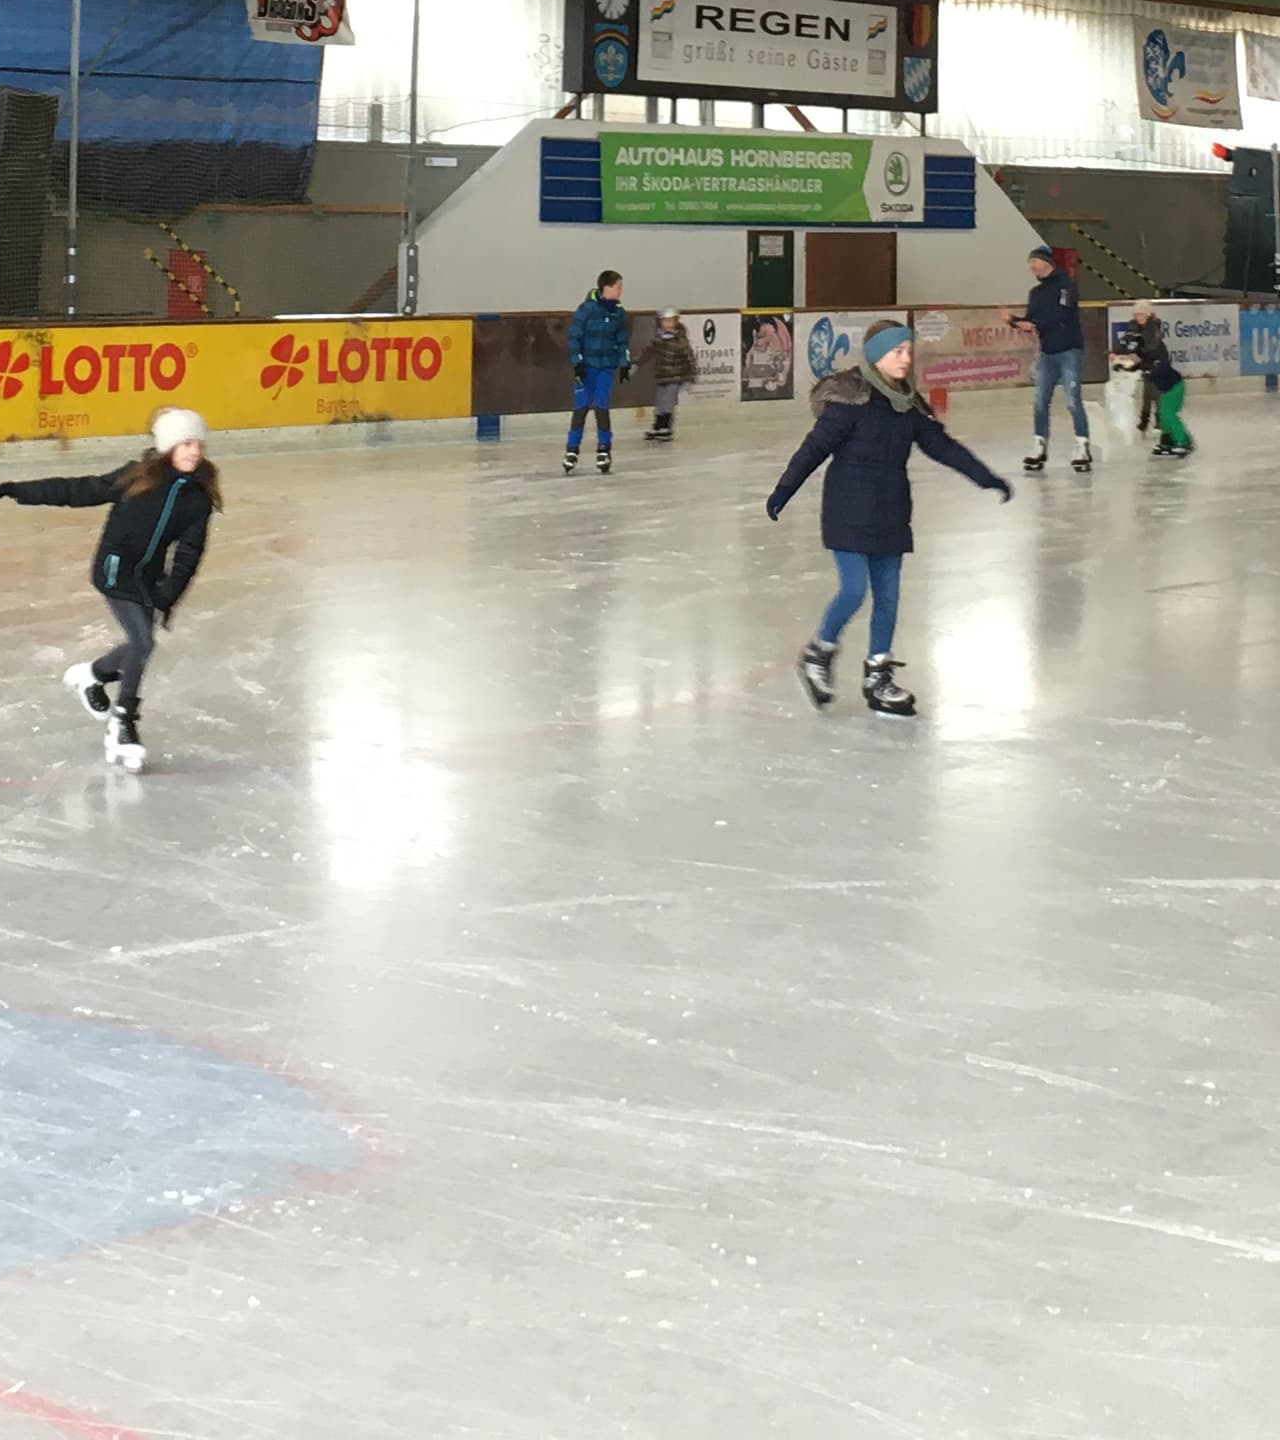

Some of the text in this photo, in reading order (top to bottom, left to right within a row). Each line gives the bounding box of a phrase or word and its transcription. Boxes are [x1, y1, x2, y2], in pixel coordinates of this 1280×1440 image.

[695, 4, 851, 42] REGEN
[682, 39, 859, 72] grüßt seine Gäste
[615, 146, 853, 169] AUTOHAUS HORNBERGER
[615, 172, 823, 193] IHR ŠKODA-VERTRAGSHÄNDLER
[1175, 320, 1231, 338] GenoBank
[39, 341, 187, 396] LOTTO
[319, 336, 443, 385] LOTTO
[316, 397, 360, 416] Bayern
[38, 410, 90, 431] Bayern
